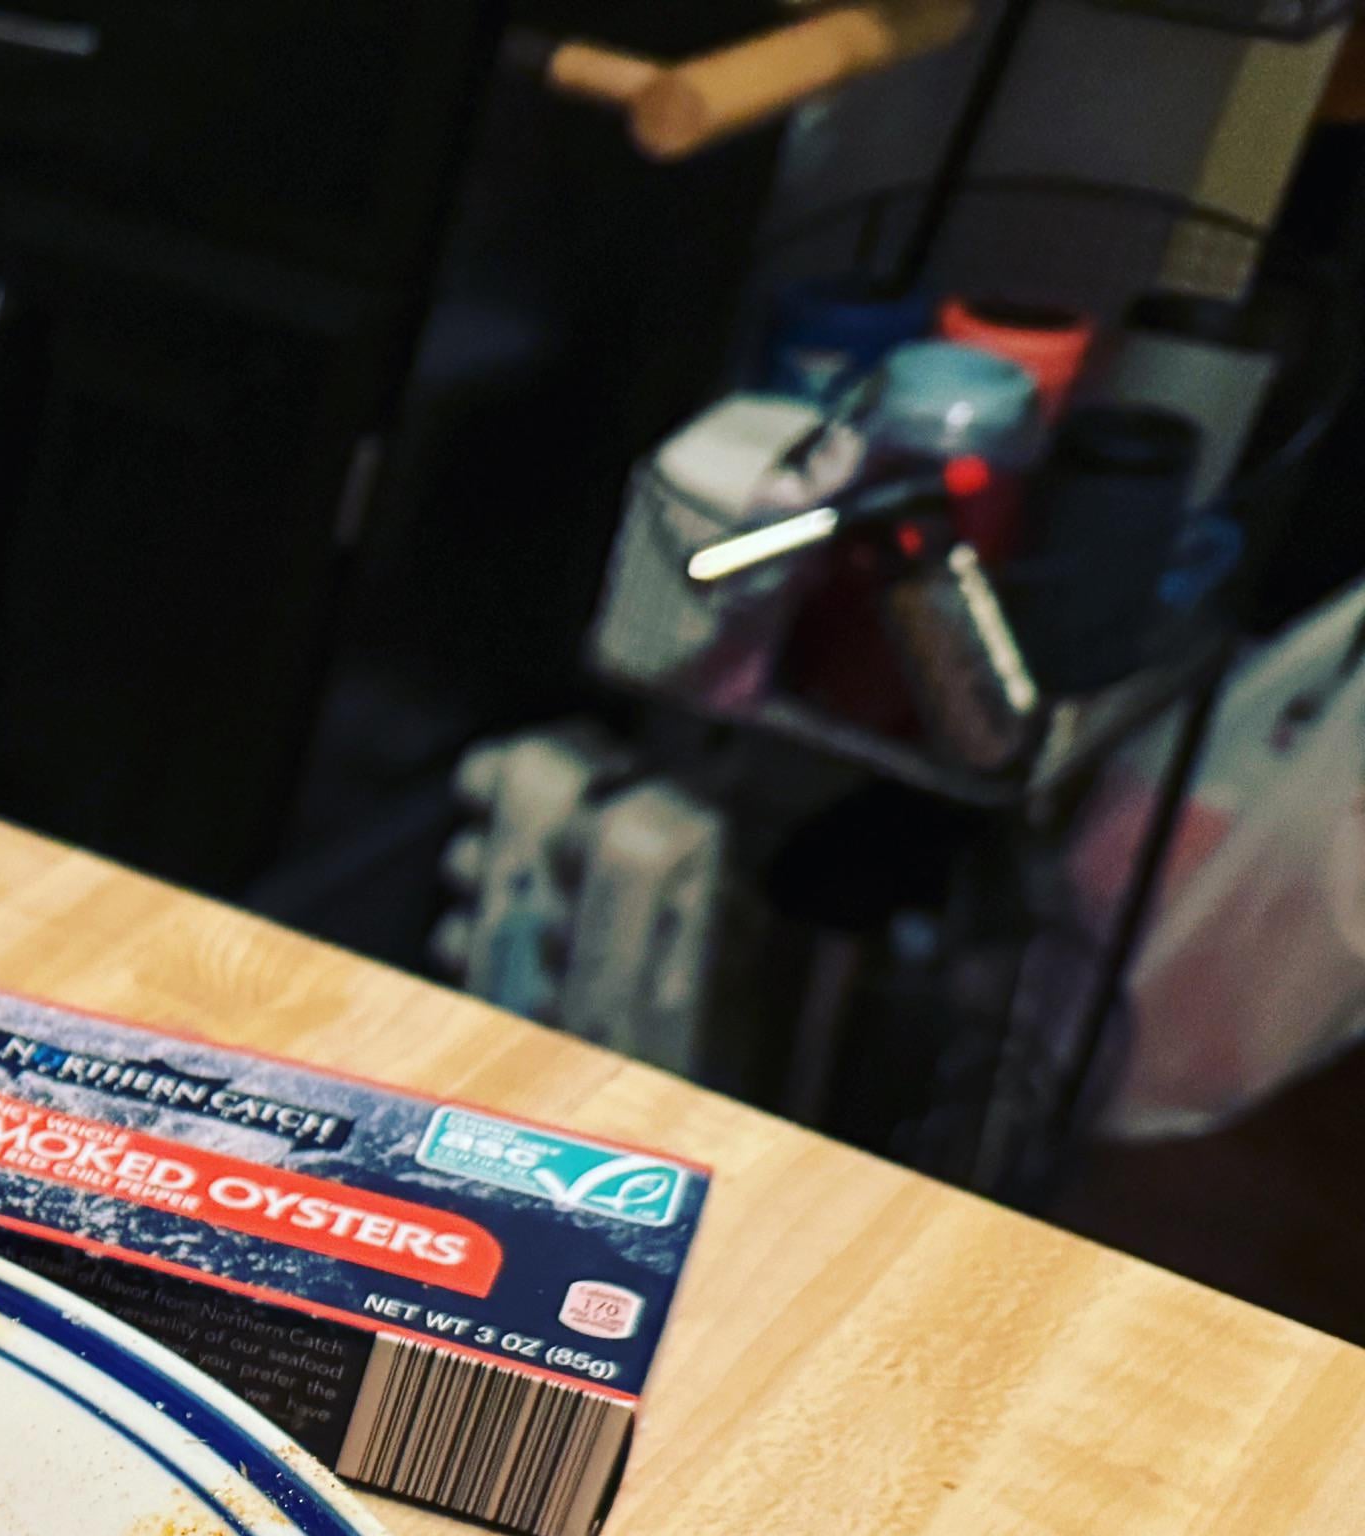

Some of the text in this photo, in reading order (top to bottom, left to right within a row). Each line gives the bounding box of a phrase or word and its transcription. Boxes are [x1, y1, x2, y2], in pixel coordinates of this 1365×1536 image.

[46, 1112, 130, 1150] WHOLE
[2, 1147, 51, 1171] RED
[115, 1177, 202, 1212] PEPPER
[208, 1176, 469, 1266] OYSTERS
[101, 1271, 151, 1300] flavor
[154, 1286, 199, 1312] from
[200, 1301, 286, 1340] Northern
[289, 1326, 344, 1356] Catch
[364, 1293, 619, 1381] NET WT 3 OZ (85g)
[197, 1352, 338, 1401] you prefer the
[204, 1328, 229, 1345] of
[230, 1337, 263, 1355] our
[268, 1349, 345, 1382] seafood
[285, 1393, 333, 1423] have
